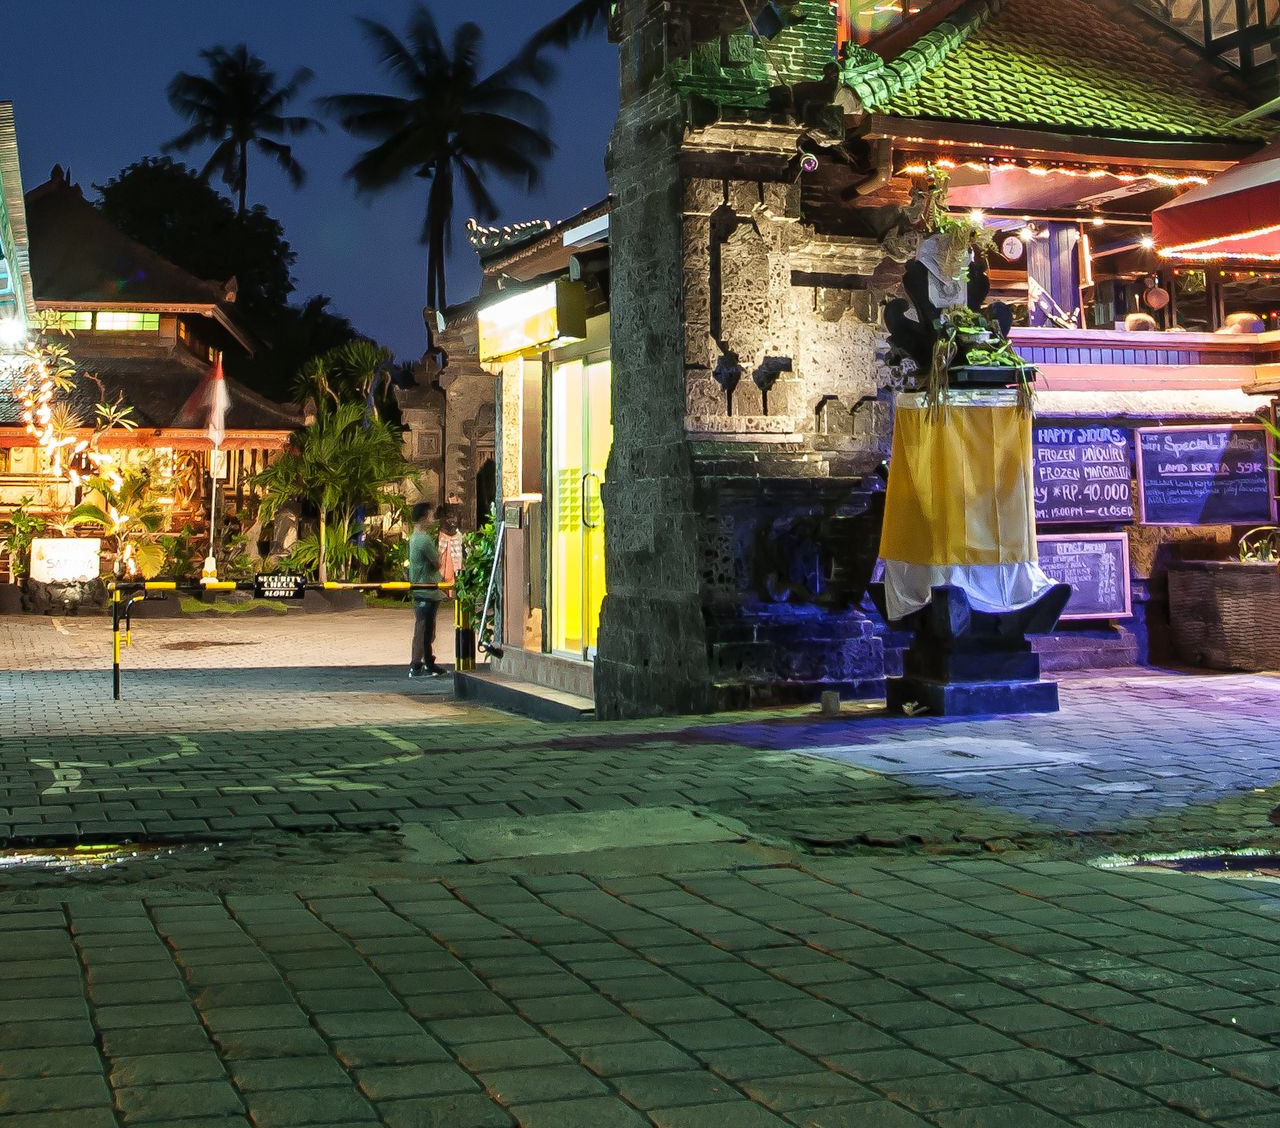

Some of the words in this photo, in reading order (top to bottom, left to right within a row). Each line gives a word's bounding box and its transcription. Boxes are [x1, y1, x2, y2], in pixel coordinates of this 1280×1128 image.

[1038, 448, 1076, 462] FROZEN
[1040, 466, 1080, 481] FROZEN
[1098, 505, 1133, 517] CLOSED
[258, 575, 301, 583] SECURITY
